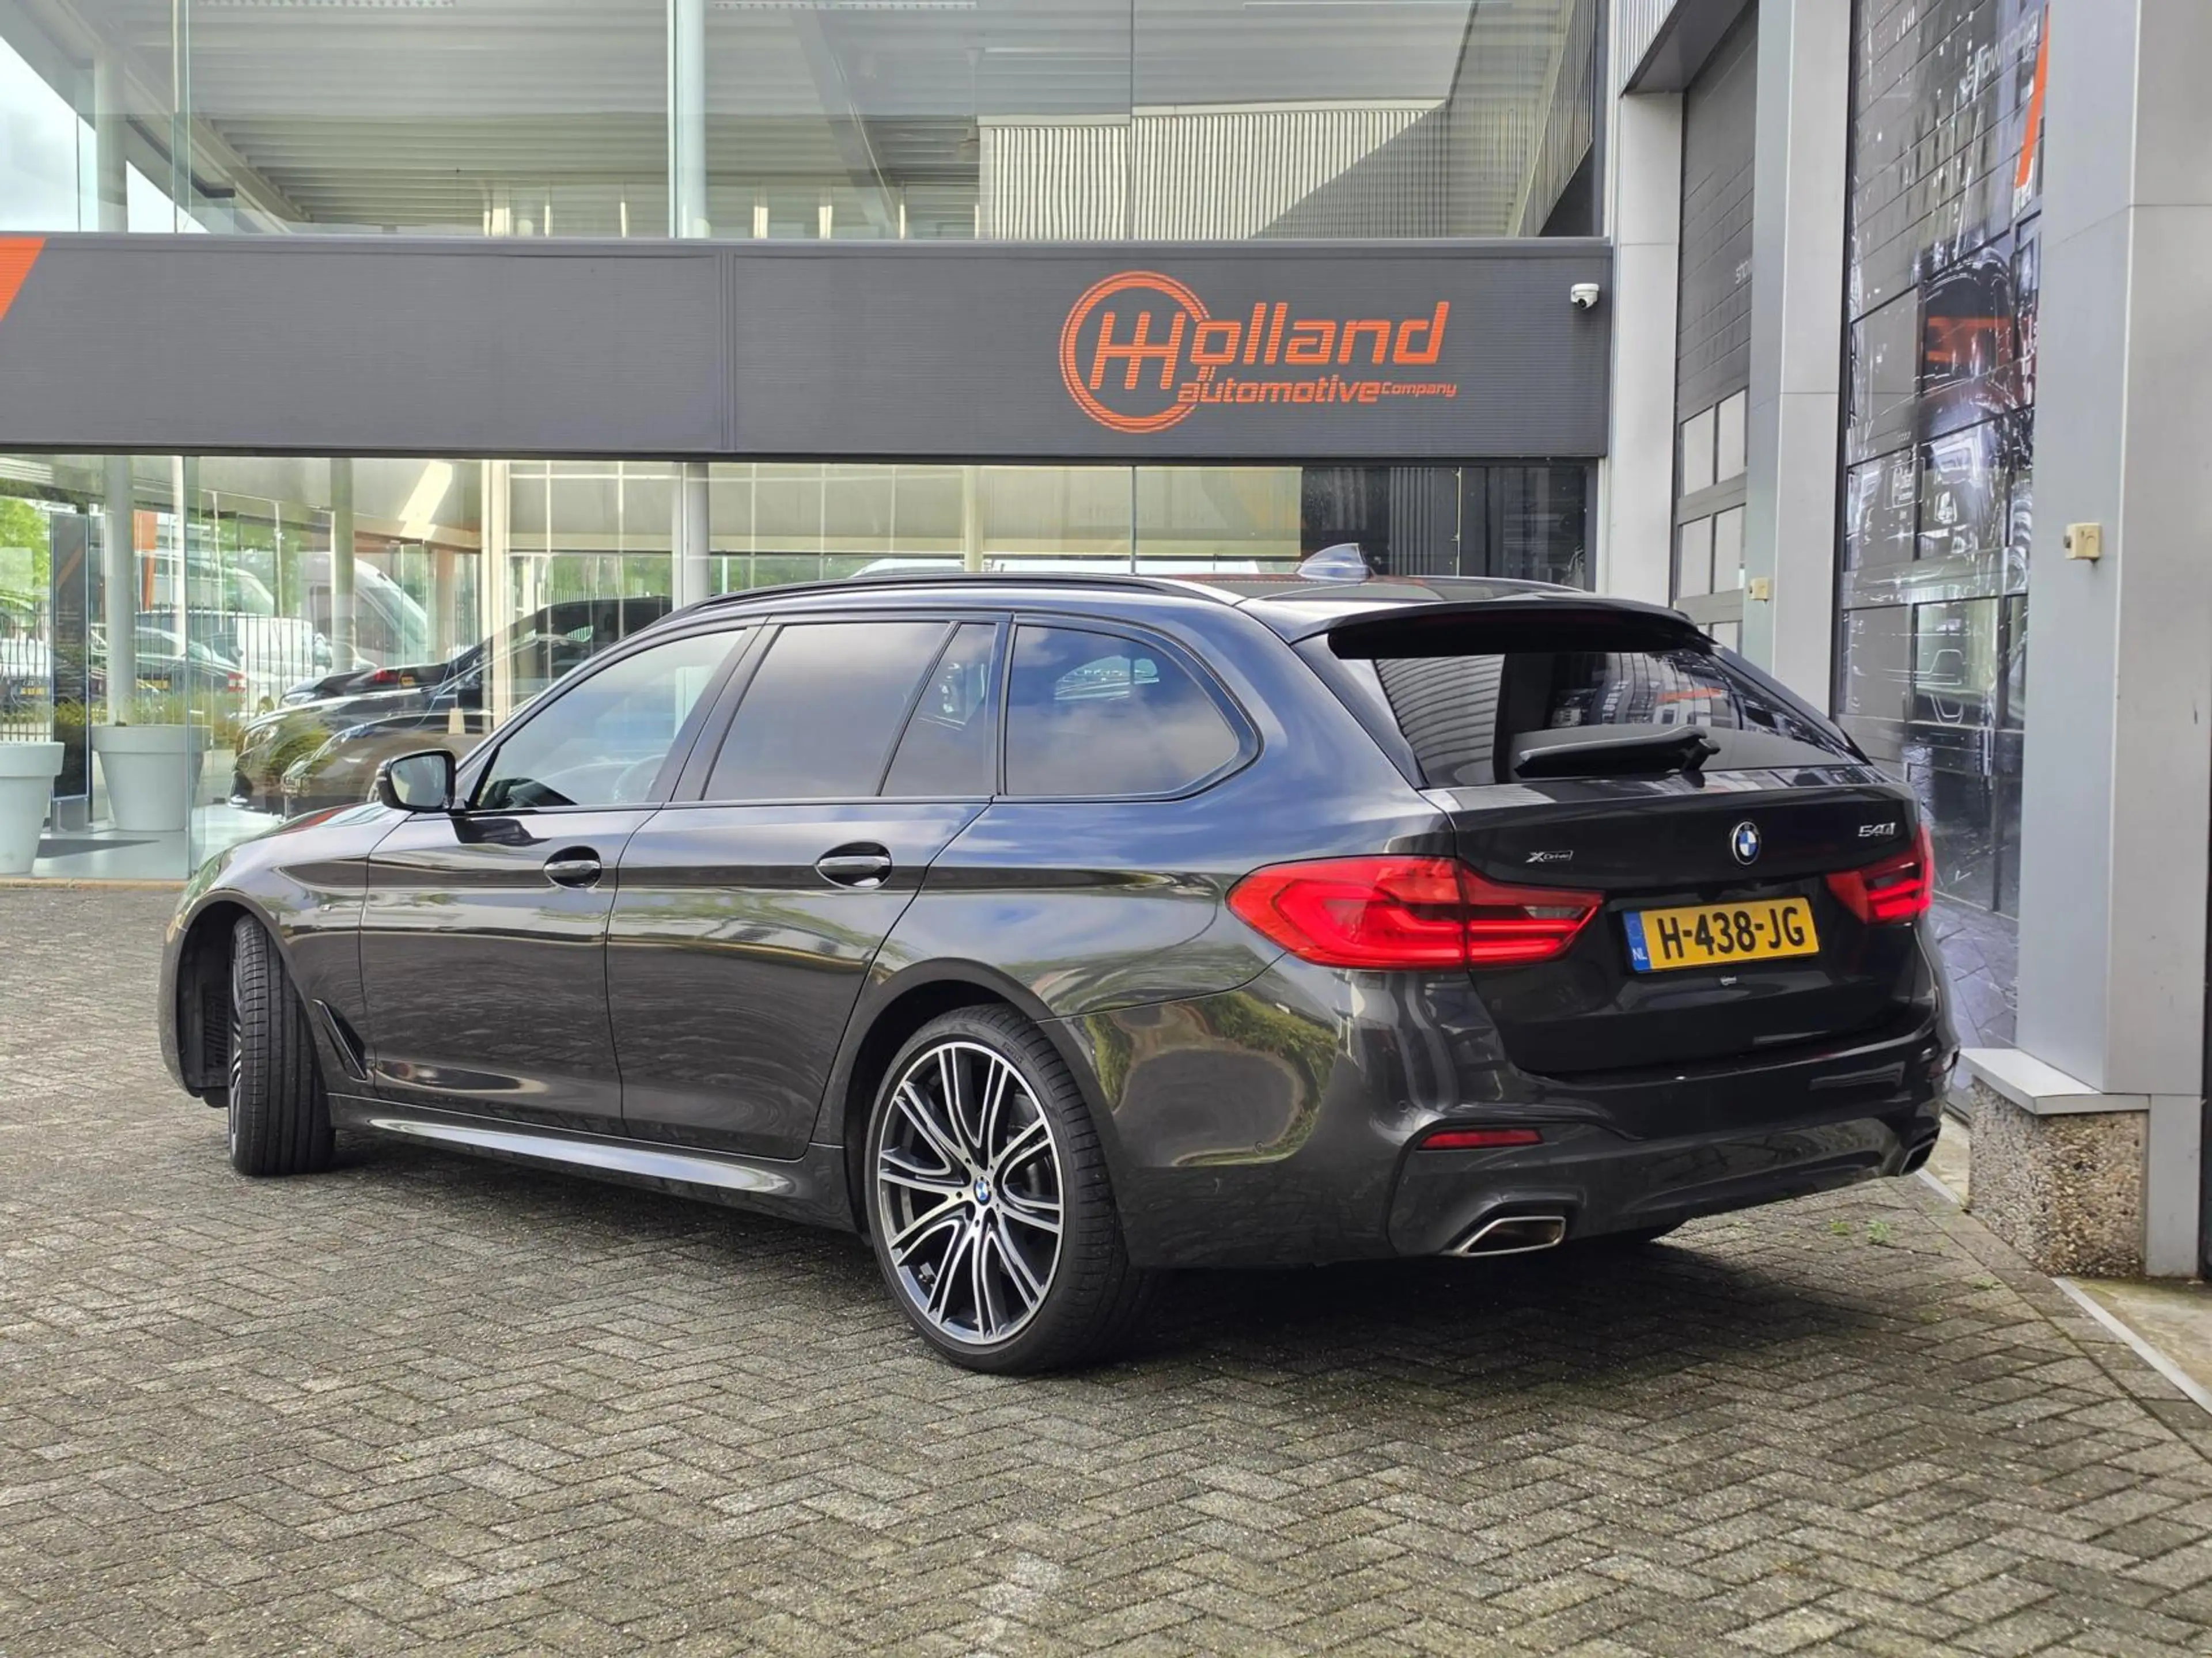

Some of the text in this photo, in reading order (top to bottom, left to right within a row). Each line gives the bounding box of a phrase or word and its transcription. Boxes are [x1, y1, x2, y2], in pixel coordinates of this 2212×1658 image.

[1177, 374, 1457, 403] automotive Company
[1657, 906, 1805, 960] H-438-JG
[1633, 948, 1647, 961] NL
